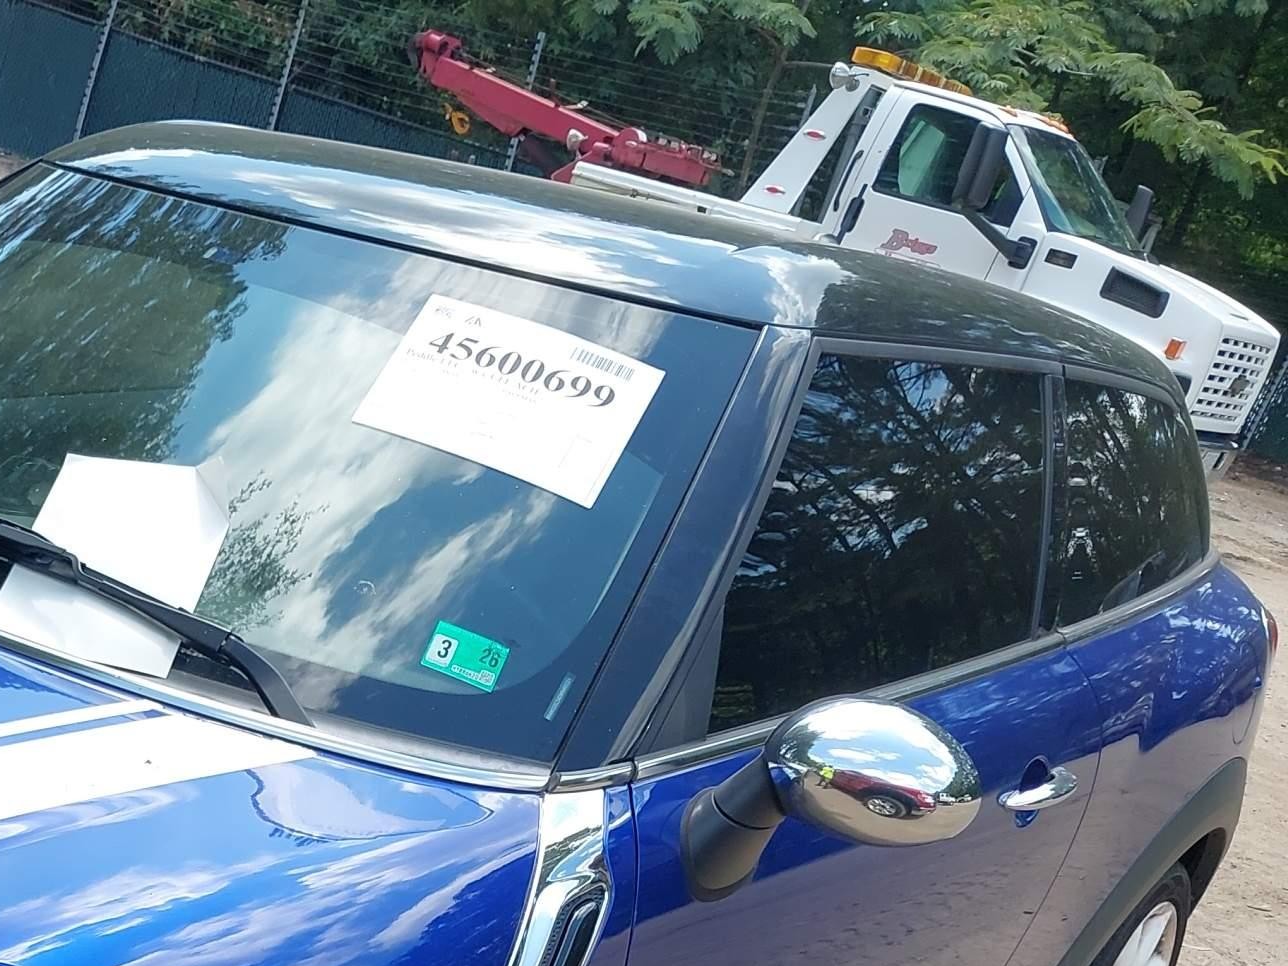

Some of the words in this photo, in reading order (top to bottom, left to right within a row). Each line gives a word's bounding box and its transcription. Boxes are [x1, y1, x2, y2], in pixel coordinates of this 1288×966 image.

[428, 331, 616, 408] 45600699
[437, 639, 452, 659] 3
[479, 647, 501, 668] 26
